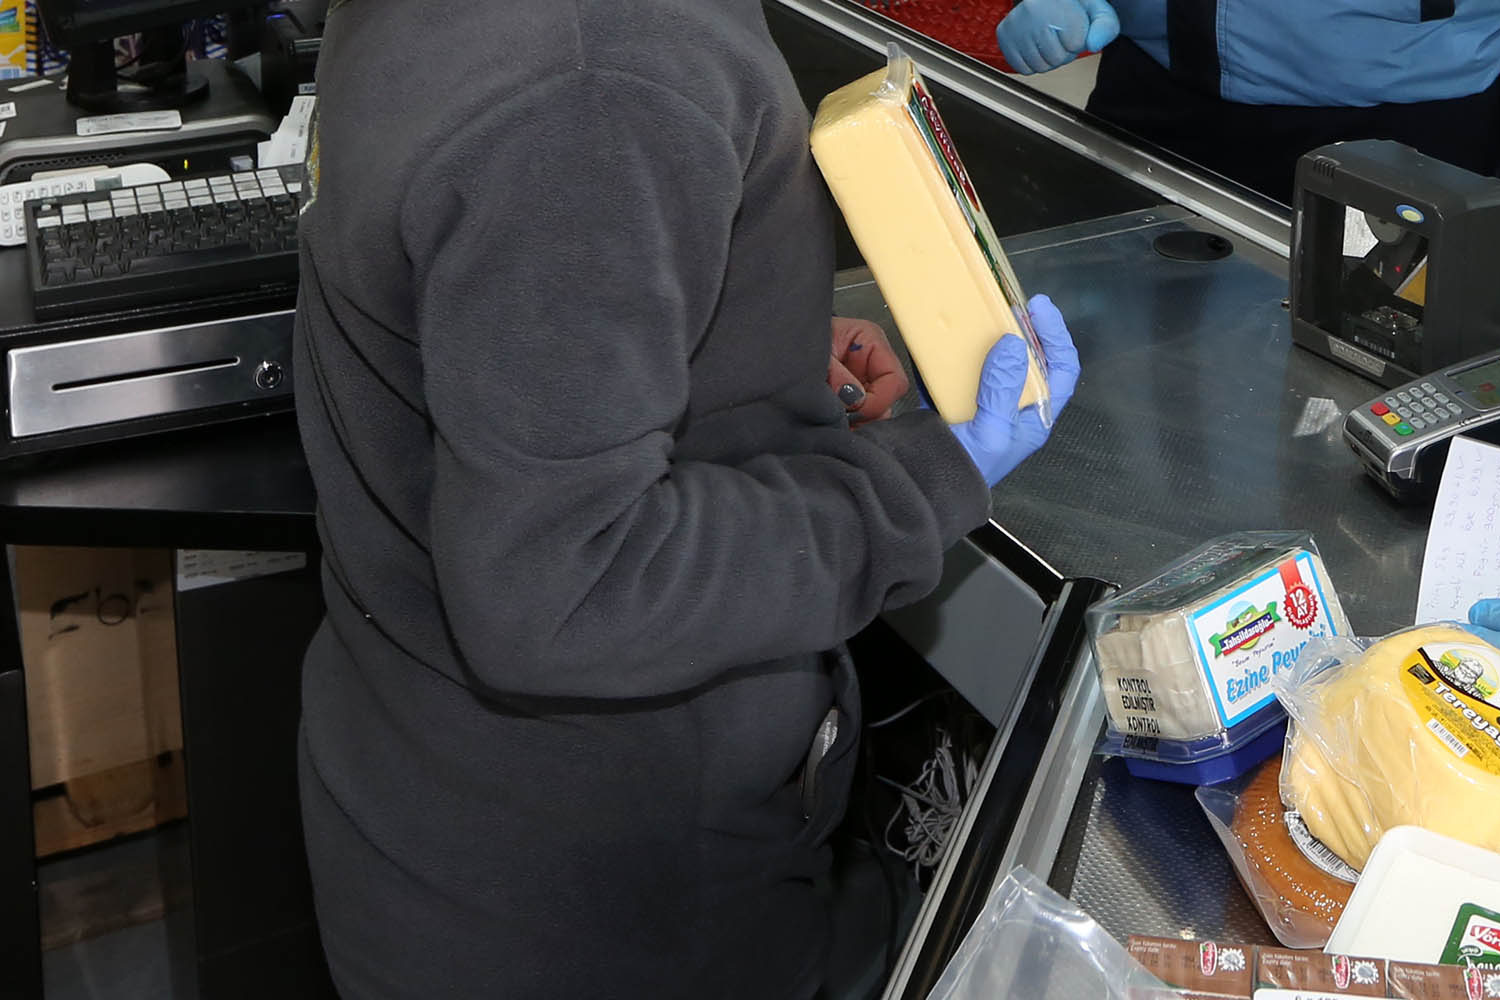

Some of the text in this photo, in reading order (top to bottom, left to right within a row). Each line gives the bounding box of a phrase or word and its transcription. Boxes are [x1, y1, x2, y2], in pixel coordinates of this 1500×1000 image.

[1289, 588, 1306, 607] 12
[1297, 602, 1308, 619] AY
[1222, 615, 1273, 651] Tahsildaroğlu
[1117, 677, 1151, 693] KONTROL
[1227, 665, 1269, 703] Ezine
[1121, 693, 1156, 714] EDİLMİŞTİR
[1127, 716, 1160, 734] KONTROL
